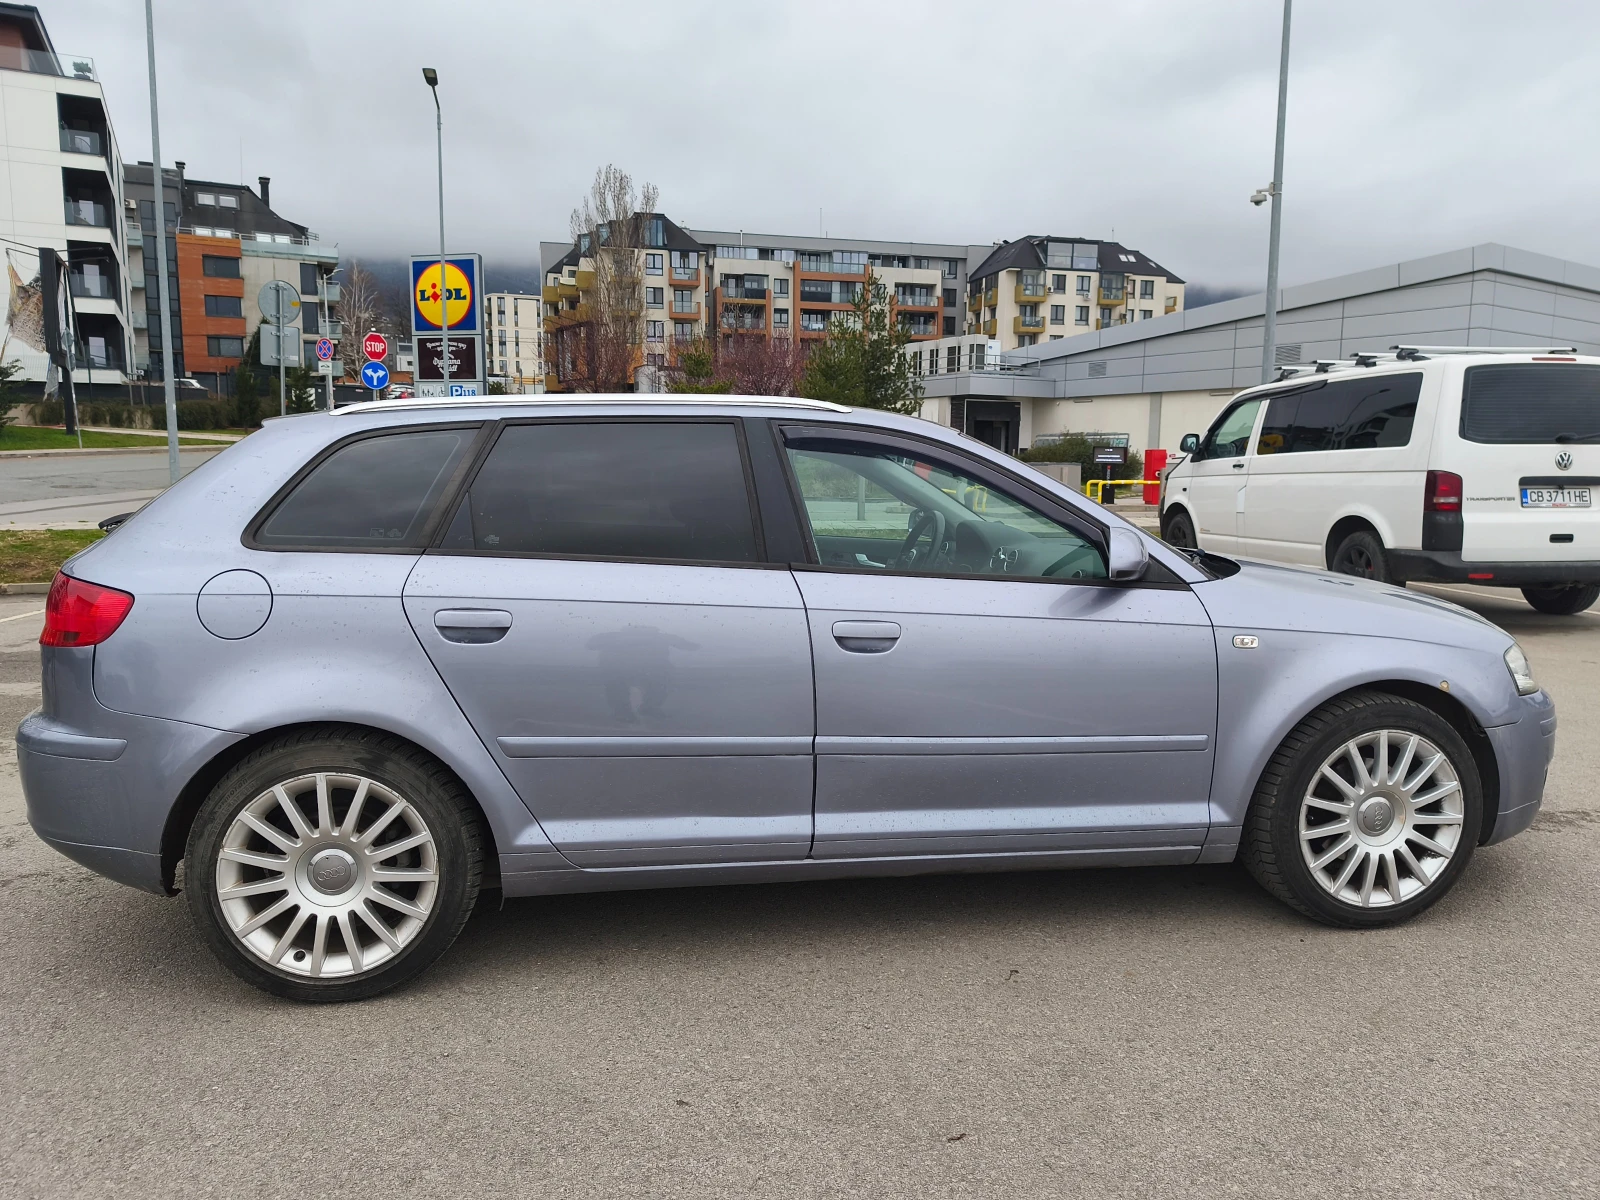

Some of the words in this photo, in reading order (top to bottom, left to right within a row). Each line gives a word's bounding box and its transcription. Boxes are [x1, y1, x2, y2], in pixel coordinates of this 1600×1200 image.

[366, 341, 385, 352] STOP
[1530, 491, 1544, 502] CB
[1546, 490, 1572, 502] 3711
[1574, 491, 1588, 502] HE
